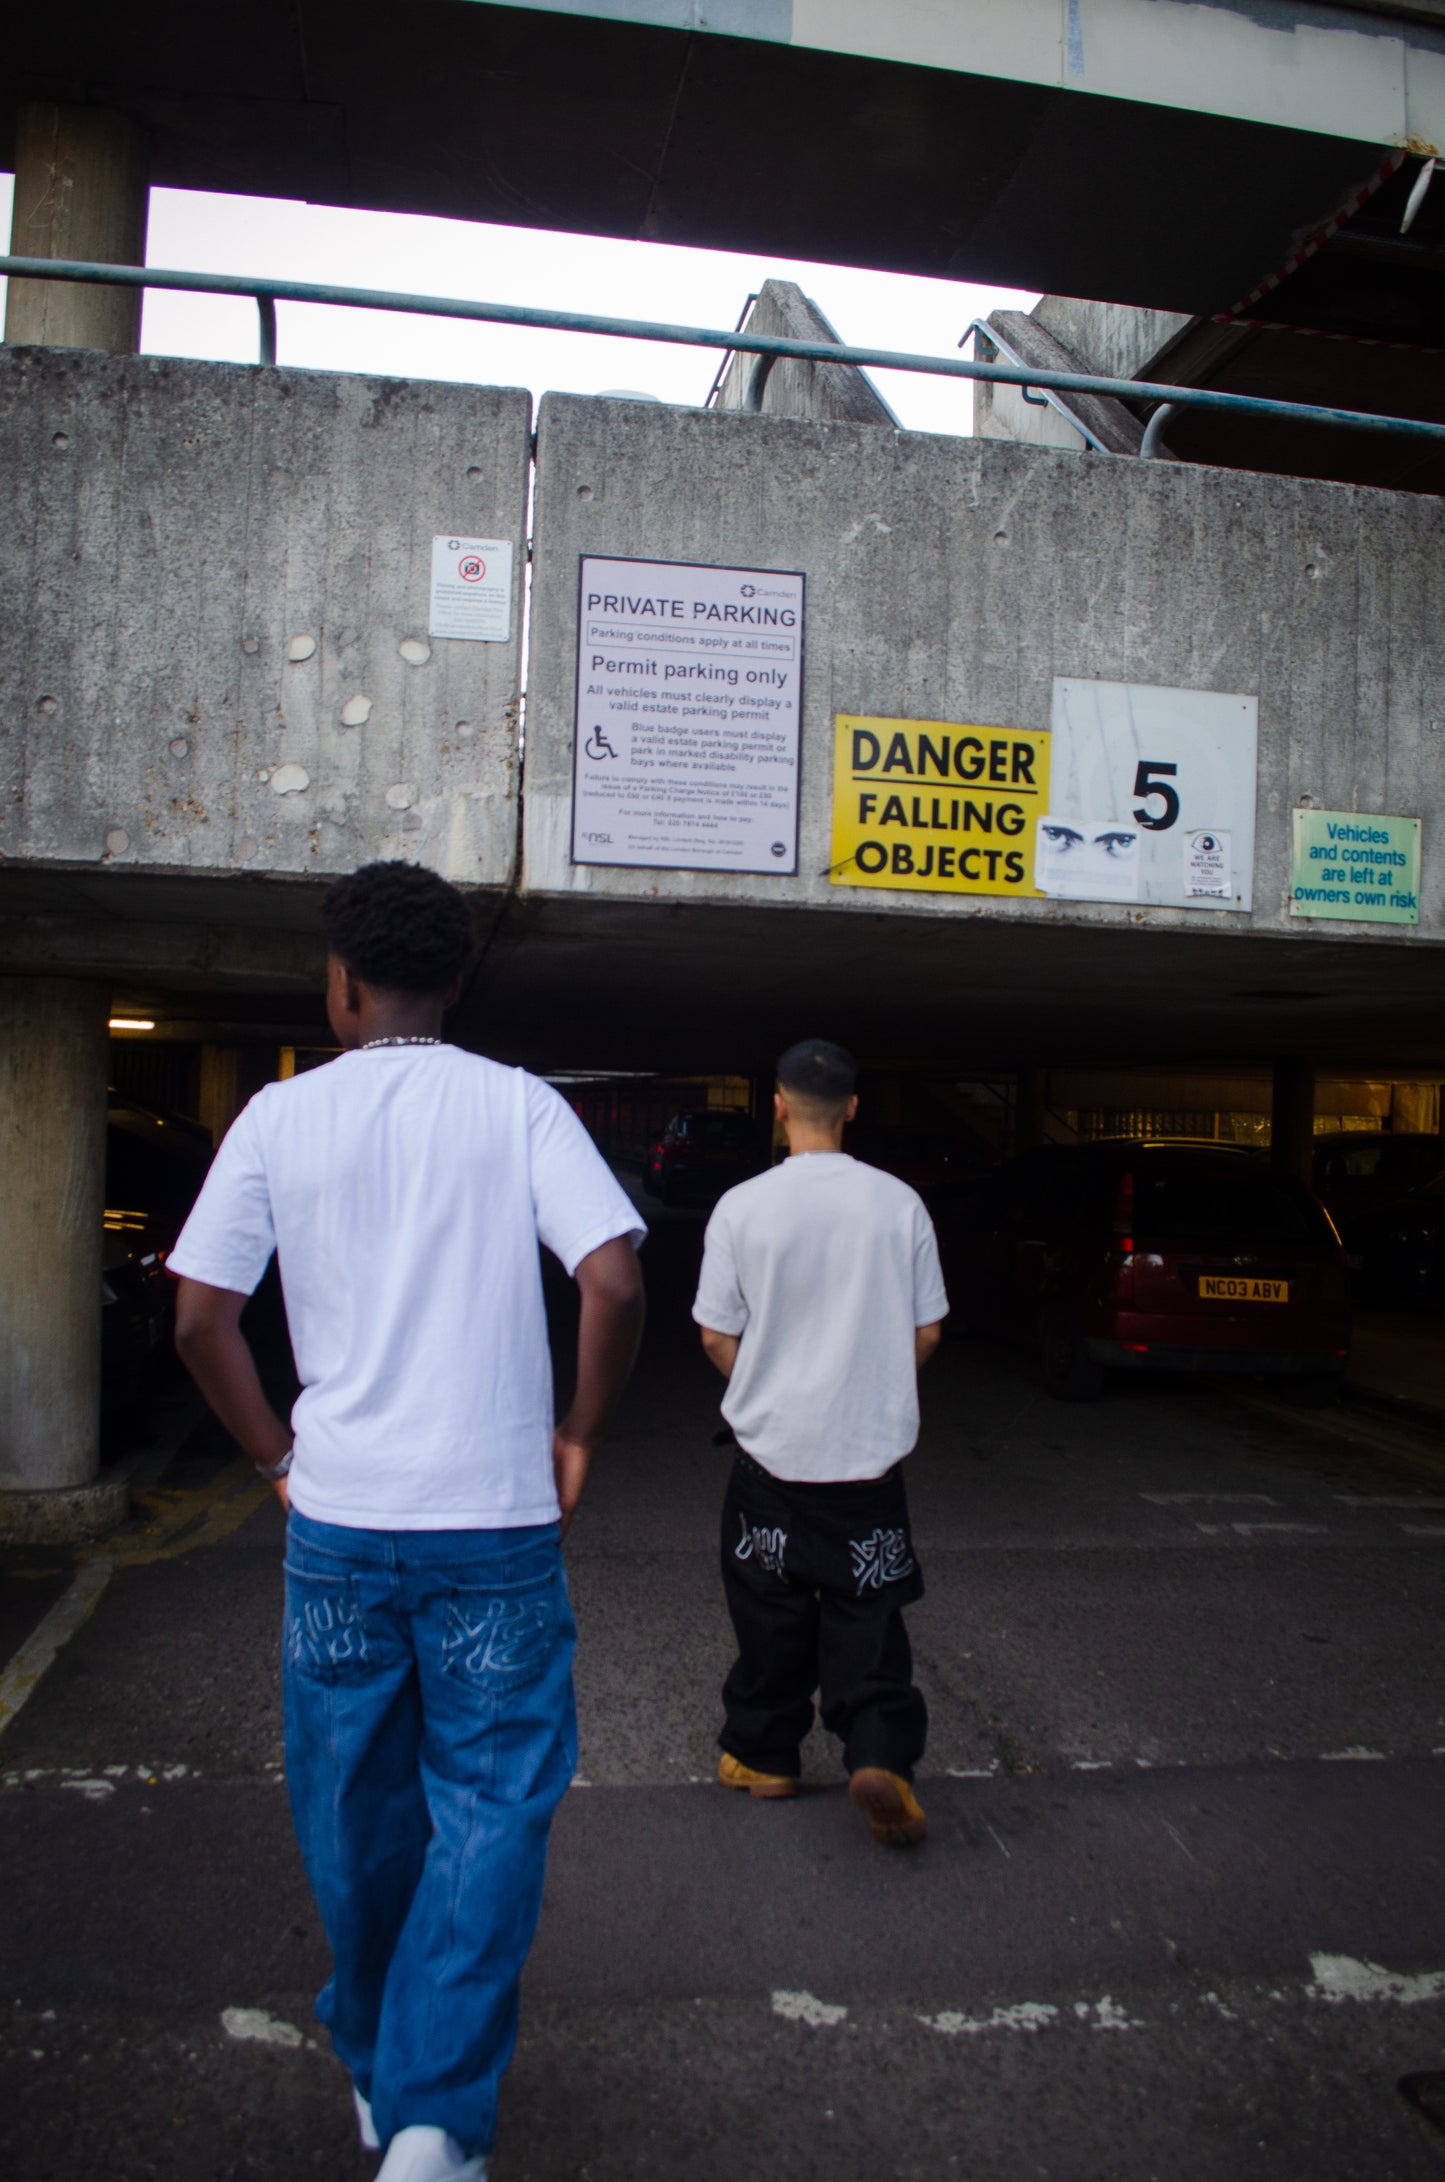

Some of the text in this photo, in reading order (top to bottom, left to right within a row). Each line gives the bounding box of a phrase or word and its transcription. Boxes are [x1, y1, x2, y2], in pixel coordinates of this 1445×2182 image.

[757, 588, 797, 598] Camden
[587, 594, 796, 626] PRIVATE PARKING
[590, 627, 790, 652] Parking conditions apply at all times
[592, 656, 788, 688] Permit parking only
[586, 684, 792, 708] All vehicles must clearly display a
[609, 700, 770, 722] valid estate parking permit
[632, 722, 786, 742] Blue badge users must display
[640, 735, 665, 745] valid
[668, 738, 698, 748] estate
[701, 738, 739, 751] parking
[741, 741, 774, 752] permit
[776, 744, 786, 752] or
[630, 746, 795, 766] park in marked disability parking
[630, 757, 736, 772] bays where available
[852, 729, 1036, 784] DANGER
[1132, 760, 1180, 831] 5
[858, 792, 1026, 836] FALLING
[1326, 822, 1390, 844] Vehicles
[855, 840, 1024, 883] OBJECTS
[1190, 861, 1224, 869] WATCHING
[1309, 844, 1406, 866] and contents
[1322, 866, 1392, 886] are left at
[1294, 886, 1416, 908] owners own risk
[1205, 1279, 1282, 1298] NC03 ABV
